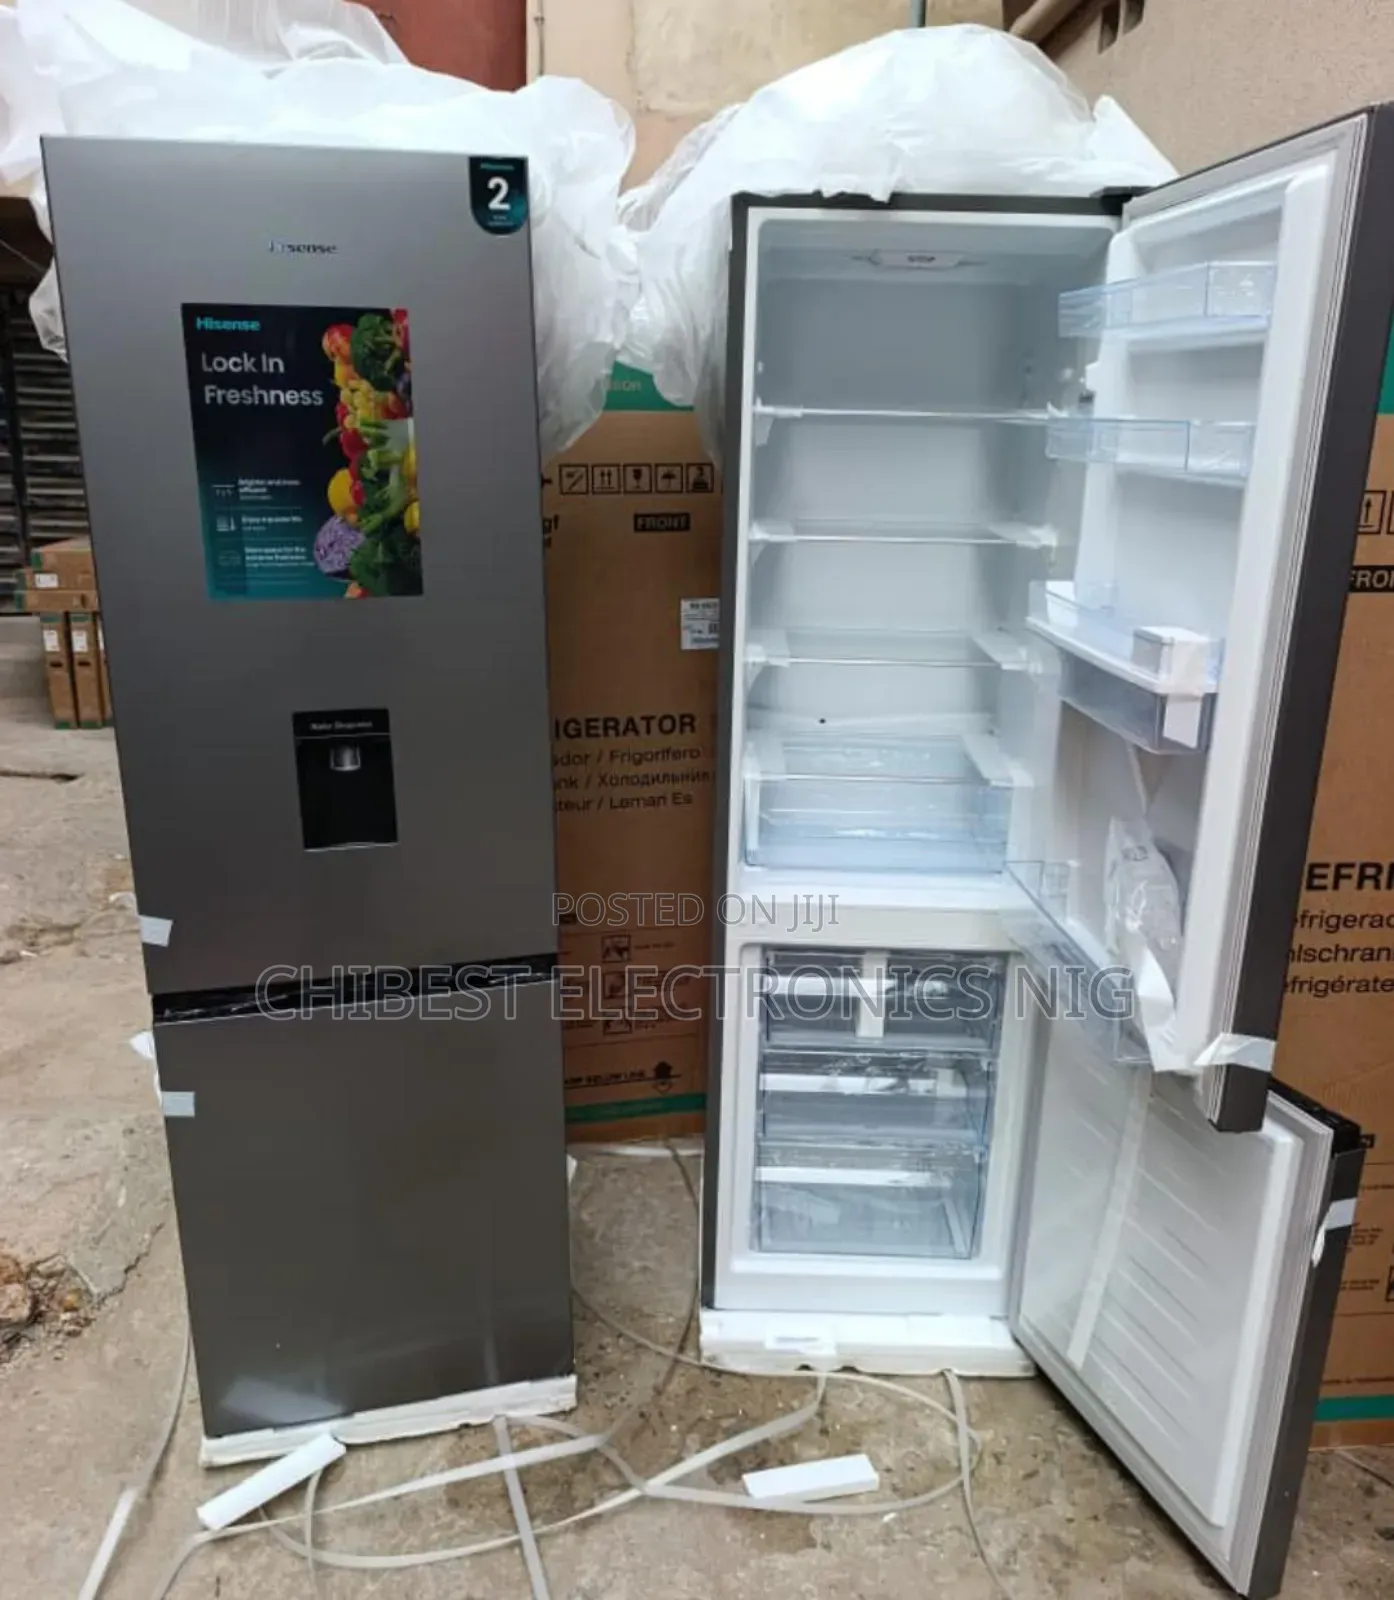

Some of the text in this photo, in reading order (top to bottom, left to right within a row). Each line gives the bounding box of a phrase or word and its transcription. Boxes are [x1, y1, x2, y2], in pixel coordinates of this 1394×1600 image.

[487, 176, 511, 211] 2
[196, 316, 261, 331] Hisense
[201, 352, 285, 373] Lock In
[204, 384, 324, 406] Freshness
[554, 713, 697, 740] IGERATOR
